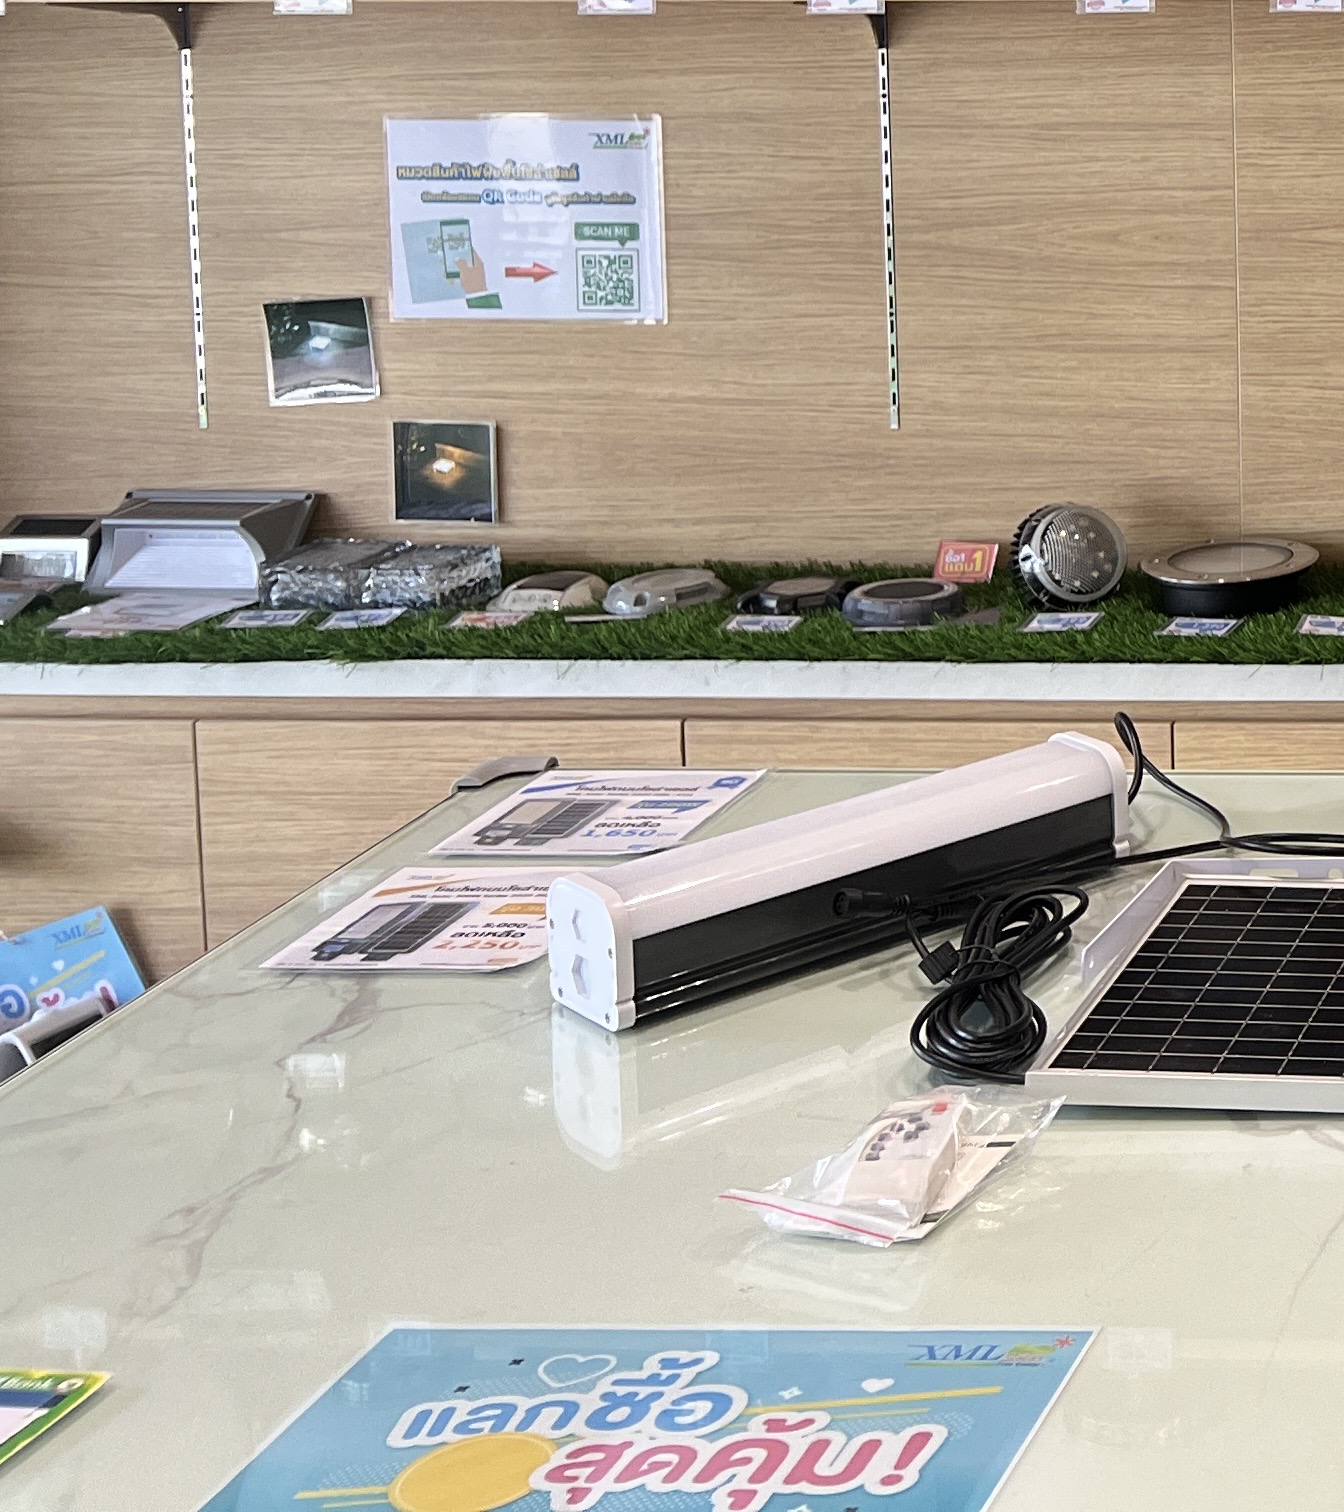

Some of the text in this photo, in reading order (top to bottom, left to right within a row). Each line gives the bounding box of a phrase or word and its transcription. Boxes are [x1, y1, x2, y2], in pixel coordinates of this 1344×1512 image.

[403, 1351, 733, 1436] แลกซื้อ
[905, 1342, 1004, 1363] XML
[544, 1414, 933, 1508] สุดคุ้ม!
